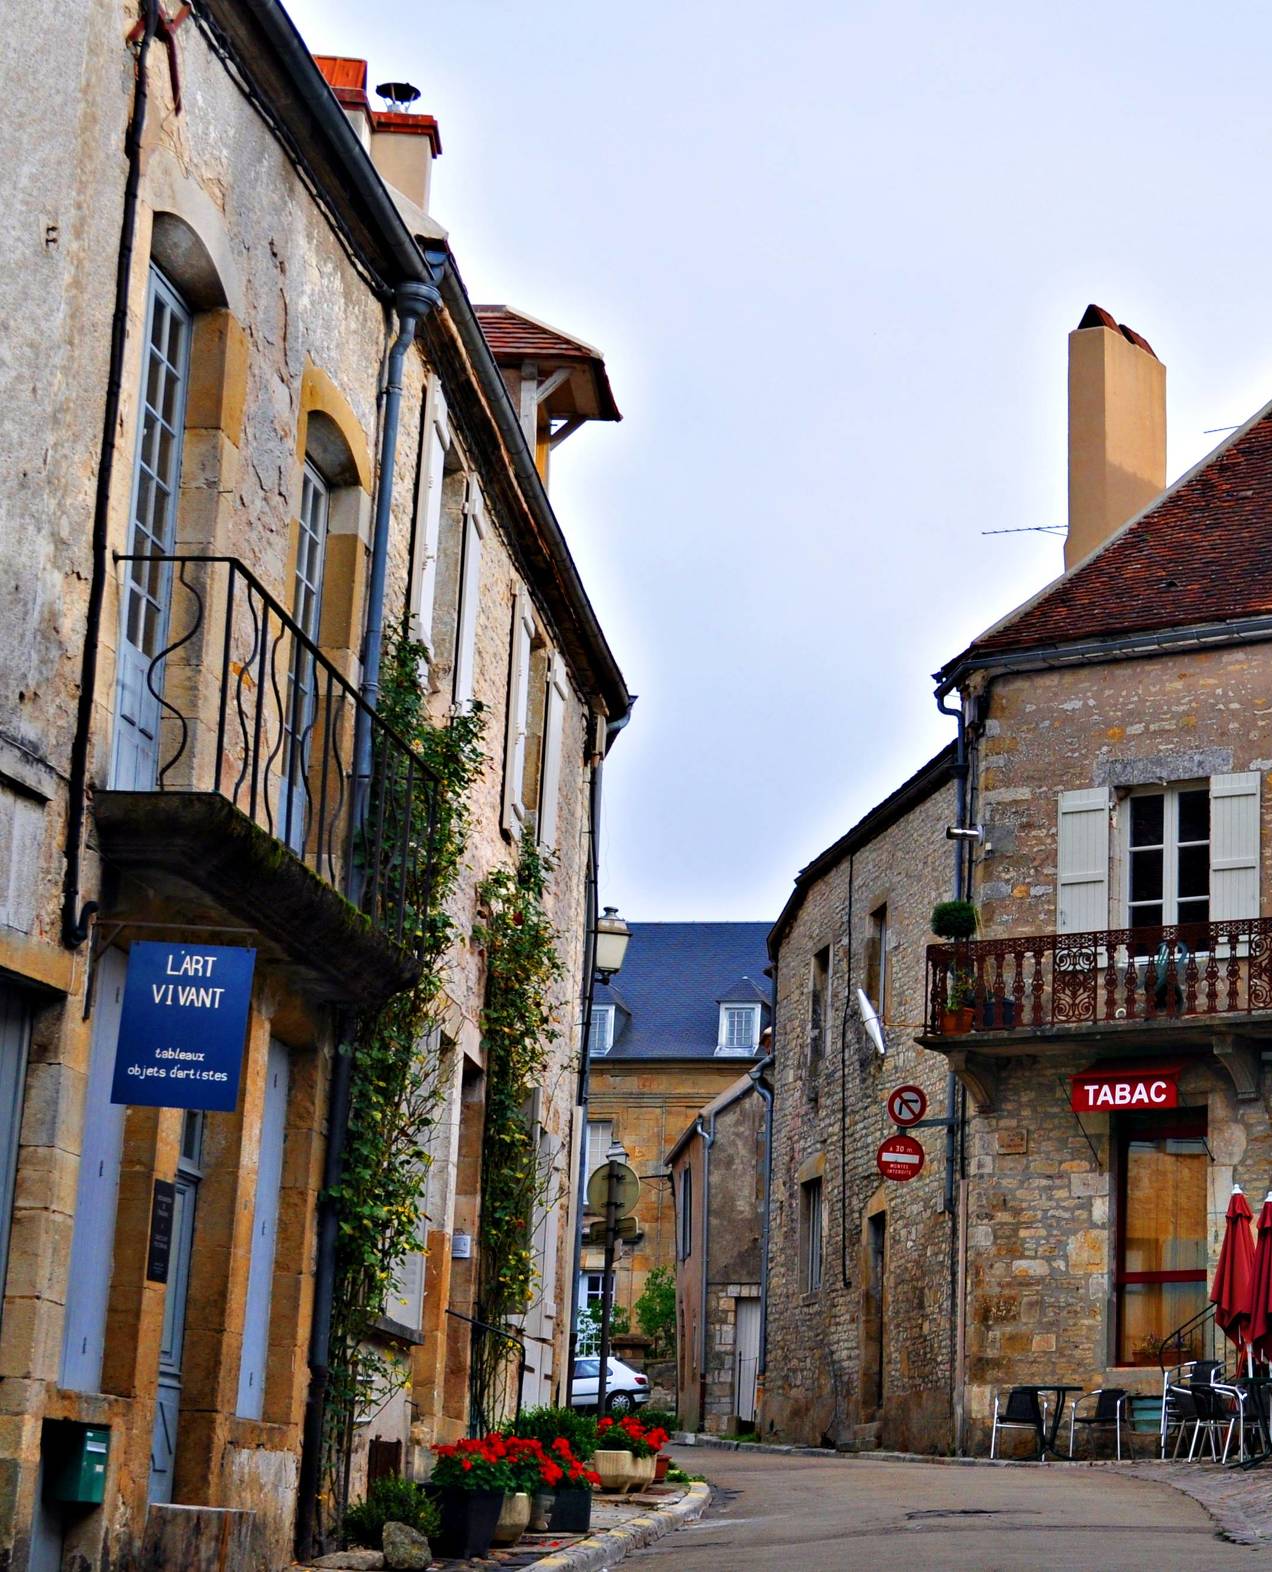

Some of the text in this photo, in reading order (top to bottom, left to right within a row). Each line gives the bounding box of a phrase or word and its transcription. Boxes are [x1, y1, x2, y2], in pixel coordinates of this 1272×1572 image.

[166, 951, 217, 977] L'ART
[152, 984, 225, 1008] VIVANT
[155, 1048, 205, 1061] tableaux
[127, 1064, 228, 1081] objets d'artistes
[1084, 1081, 1167, 1106] TABAC
